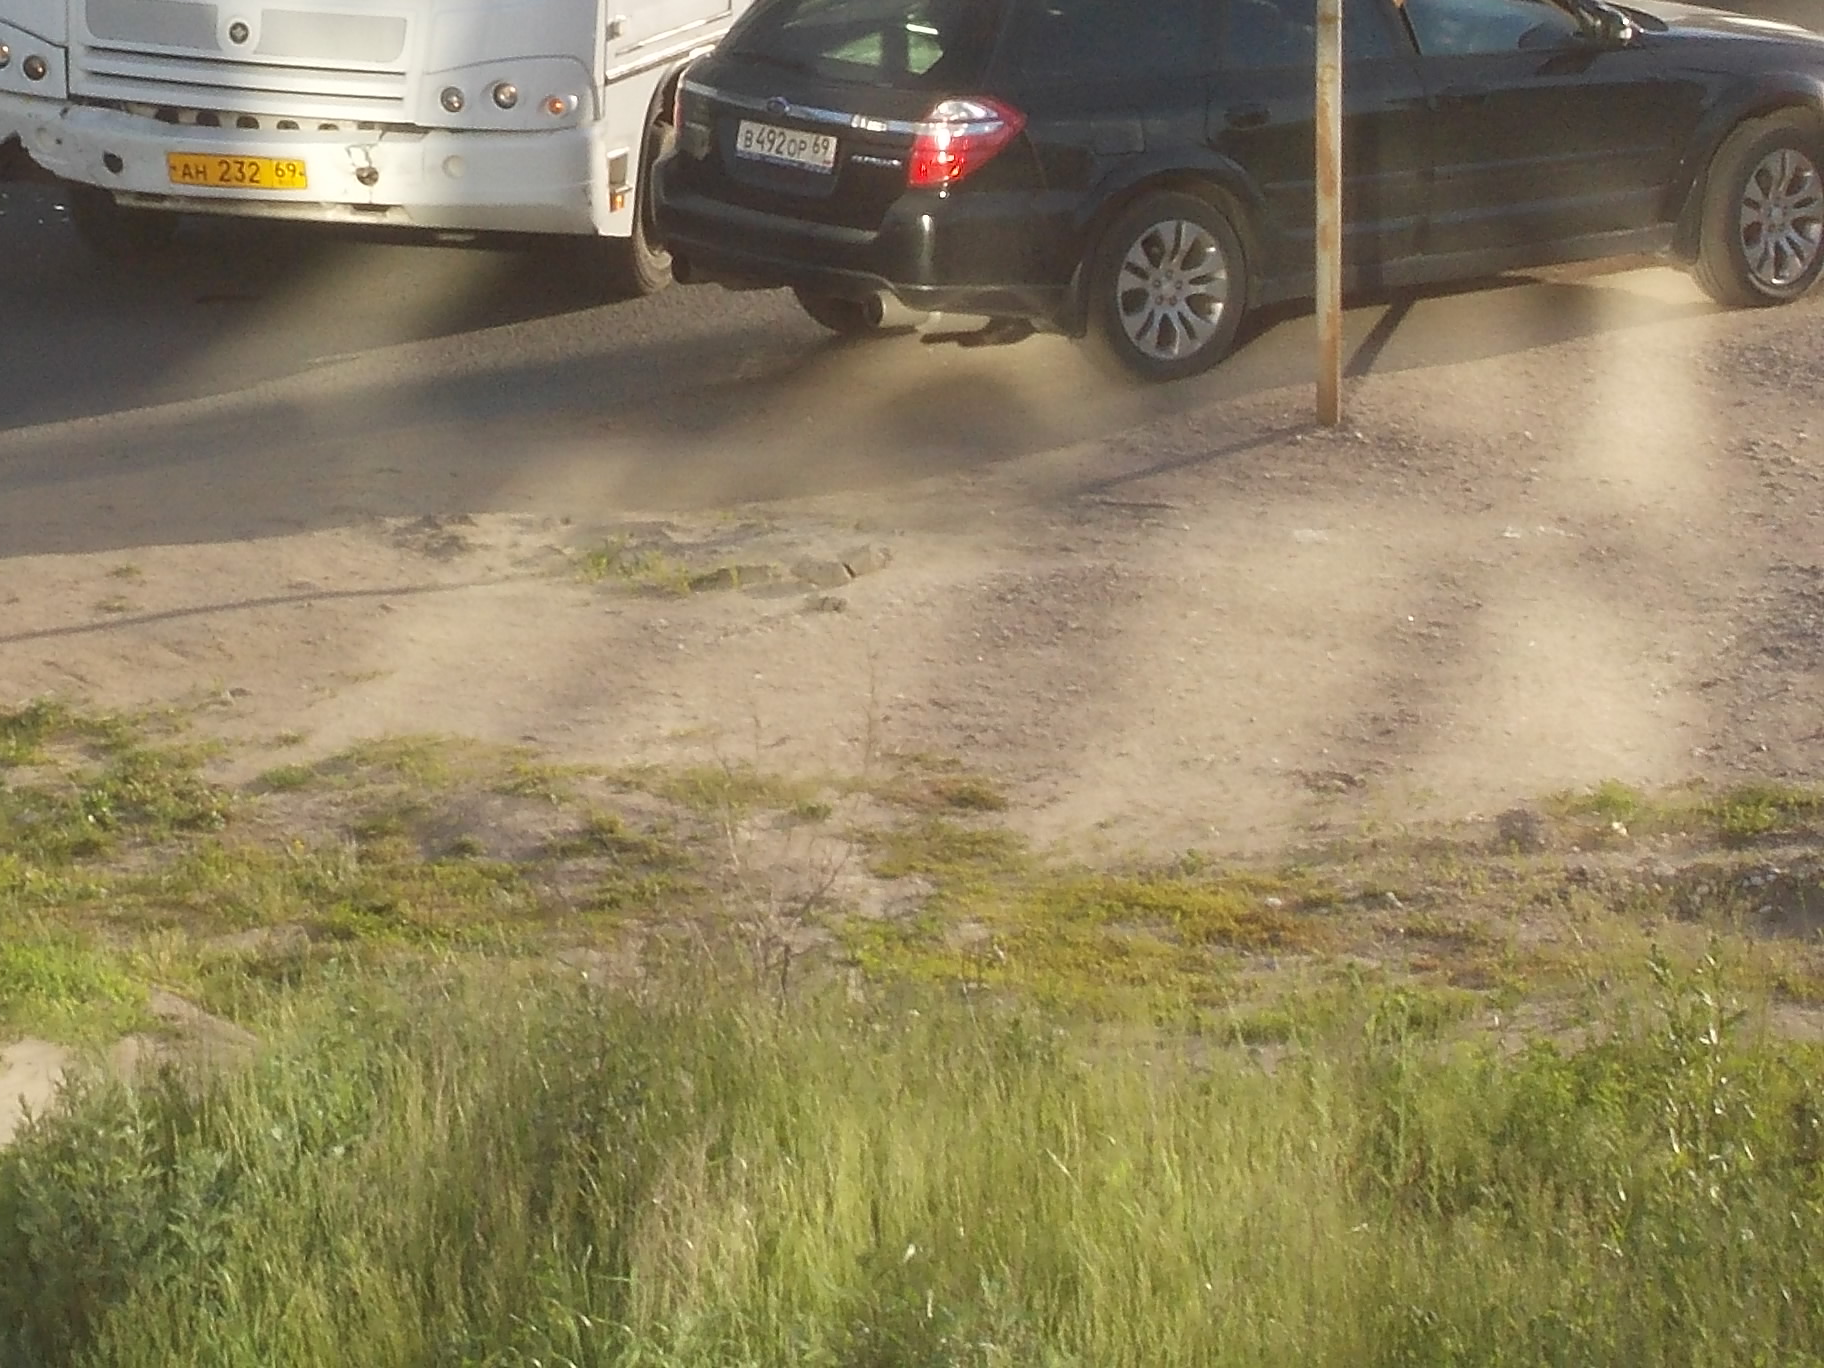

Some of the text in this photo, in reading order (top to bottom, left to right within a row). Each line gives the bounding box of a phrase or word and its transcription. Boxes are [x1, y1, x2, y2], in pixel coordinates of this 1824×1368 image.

[812, 136, 831, 156] 69
[181, 158, 297, 184] АН 232 69
